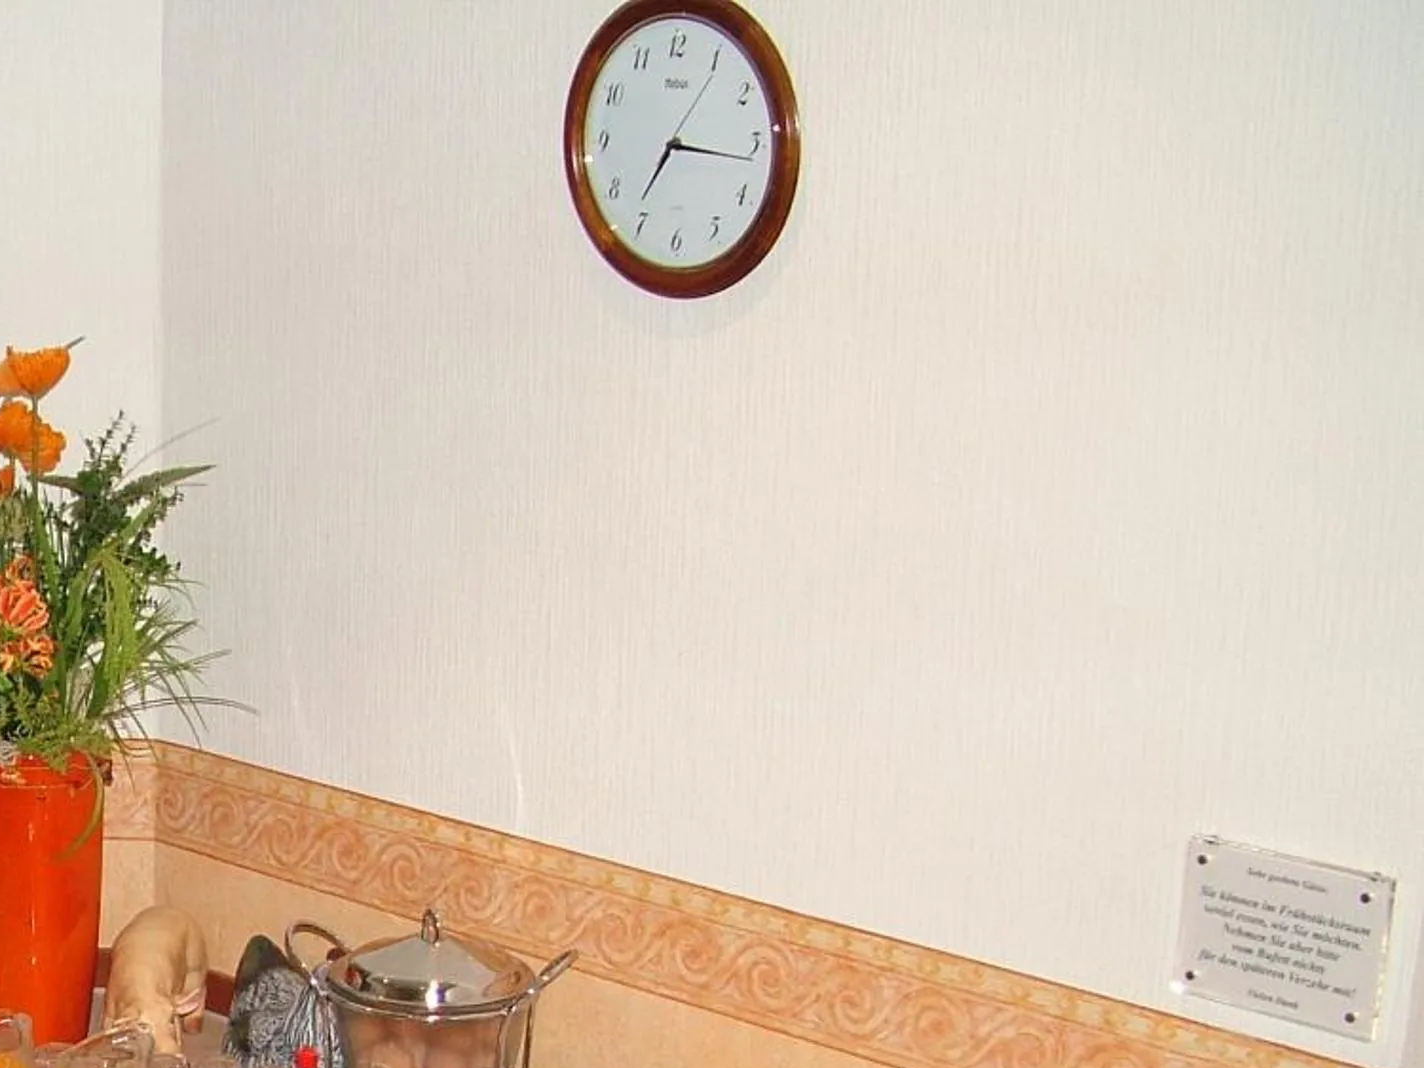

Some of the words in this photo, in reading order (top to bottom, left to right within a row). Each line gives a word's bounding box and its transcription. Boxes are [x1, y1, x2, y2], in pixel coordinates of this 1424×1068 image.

[669, 30, 687, 58] 12
[633, 46, 650, 70] 11
[711, 46, 720, 72] 1
[606, 83, 623, 106] 10
[738, 81, 750, 105] 2
[599, 130, 609, 152] 9
[750, 131, 761, 156] 3
[609, 178, 620, 200] 8
[736, 184, 748, 207] 4
[637, 212, 649, 239] 7
[709, 216, 721, 241] 5
[670, 229, 682, 251] 6
